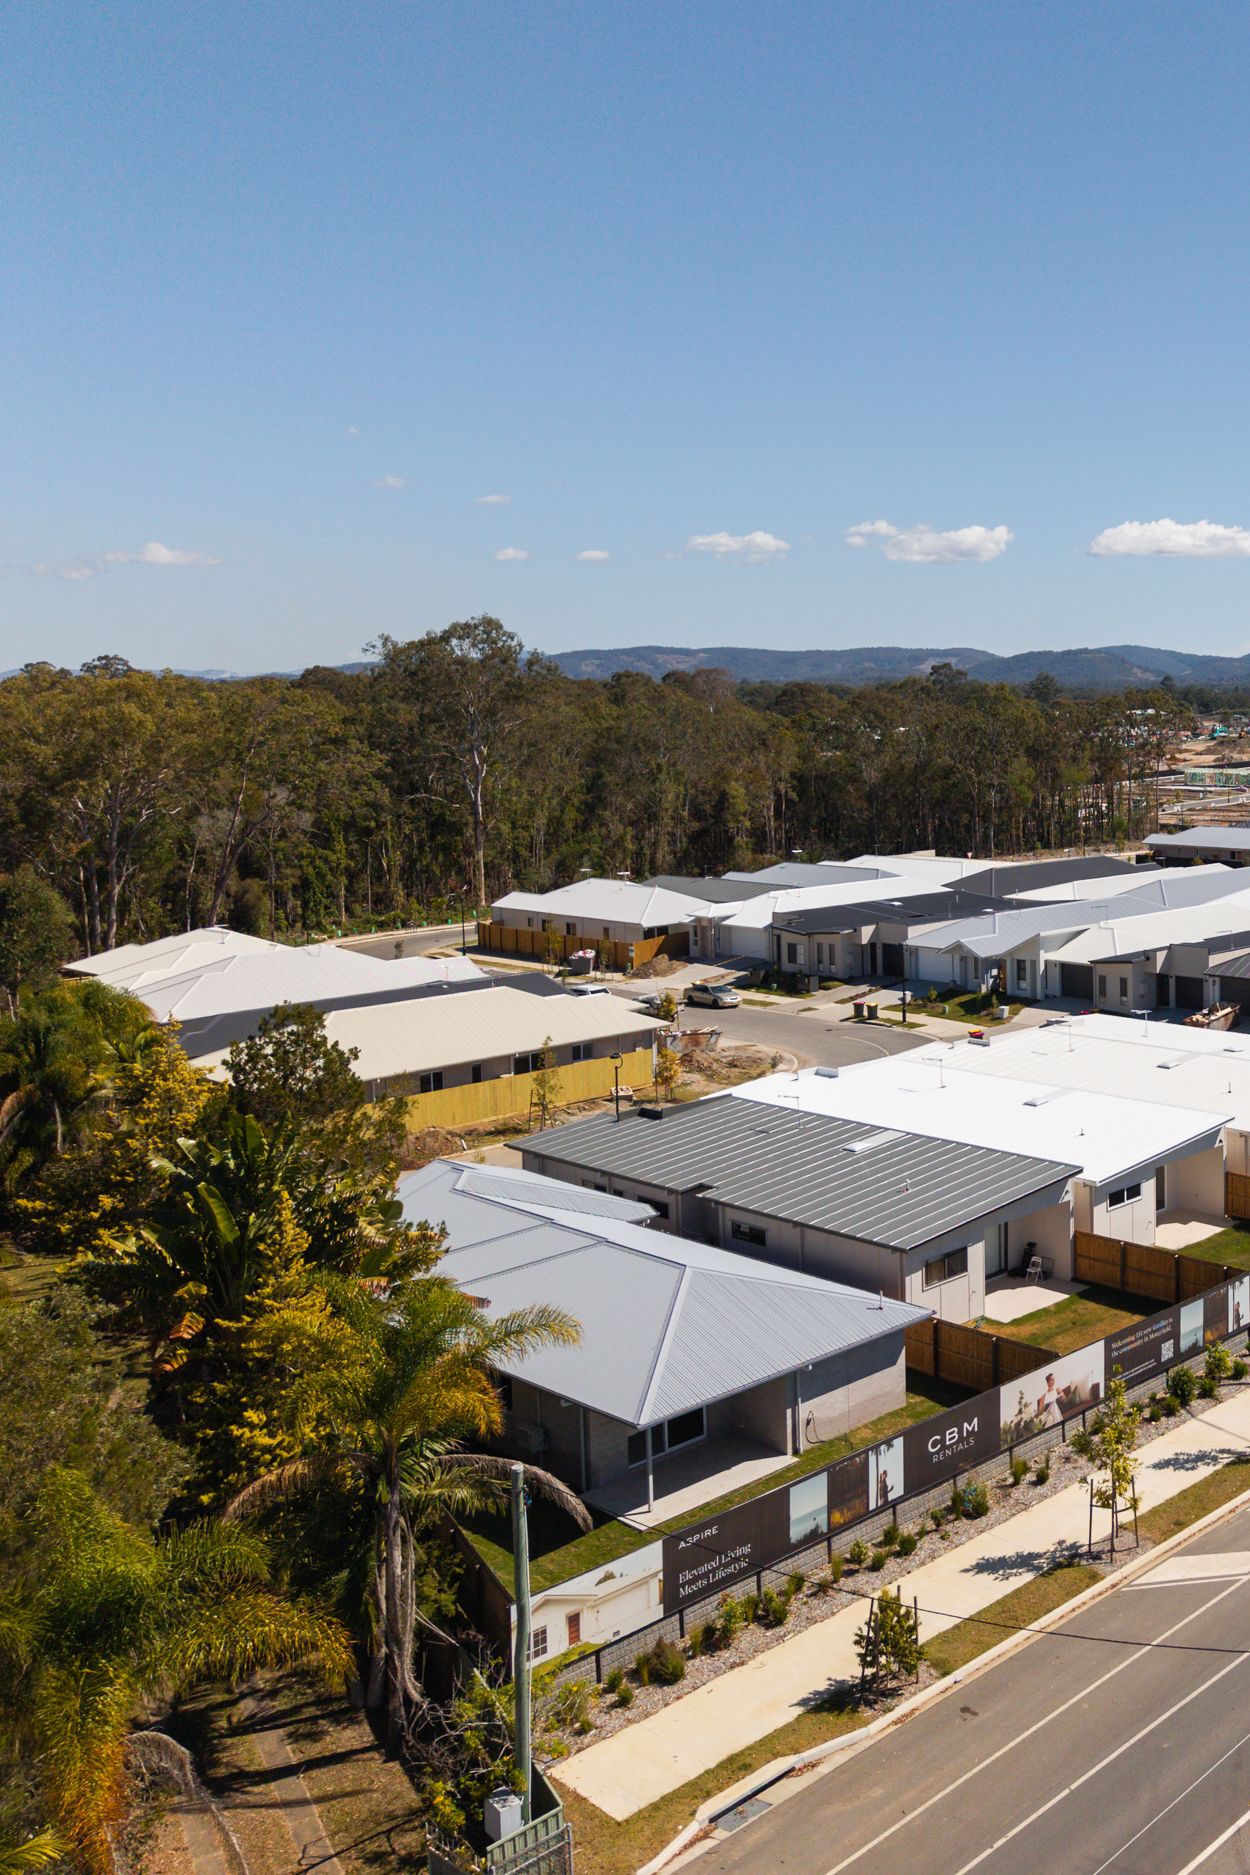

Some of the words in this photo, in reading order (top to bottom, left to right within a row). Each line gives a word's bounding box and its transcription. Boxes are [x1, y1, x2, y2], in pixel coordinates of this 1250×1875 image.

[928, 1417, 978, 1452] CBM
[933, 1437, 974, 1463] RENTALS
[678, 1525, 719, 1550] ASPIRE
[679, 1555, 719, 1584] Elevated
[721, 1543, 752, 1564] Living
[679, 1578, 708, 1598] Meets
